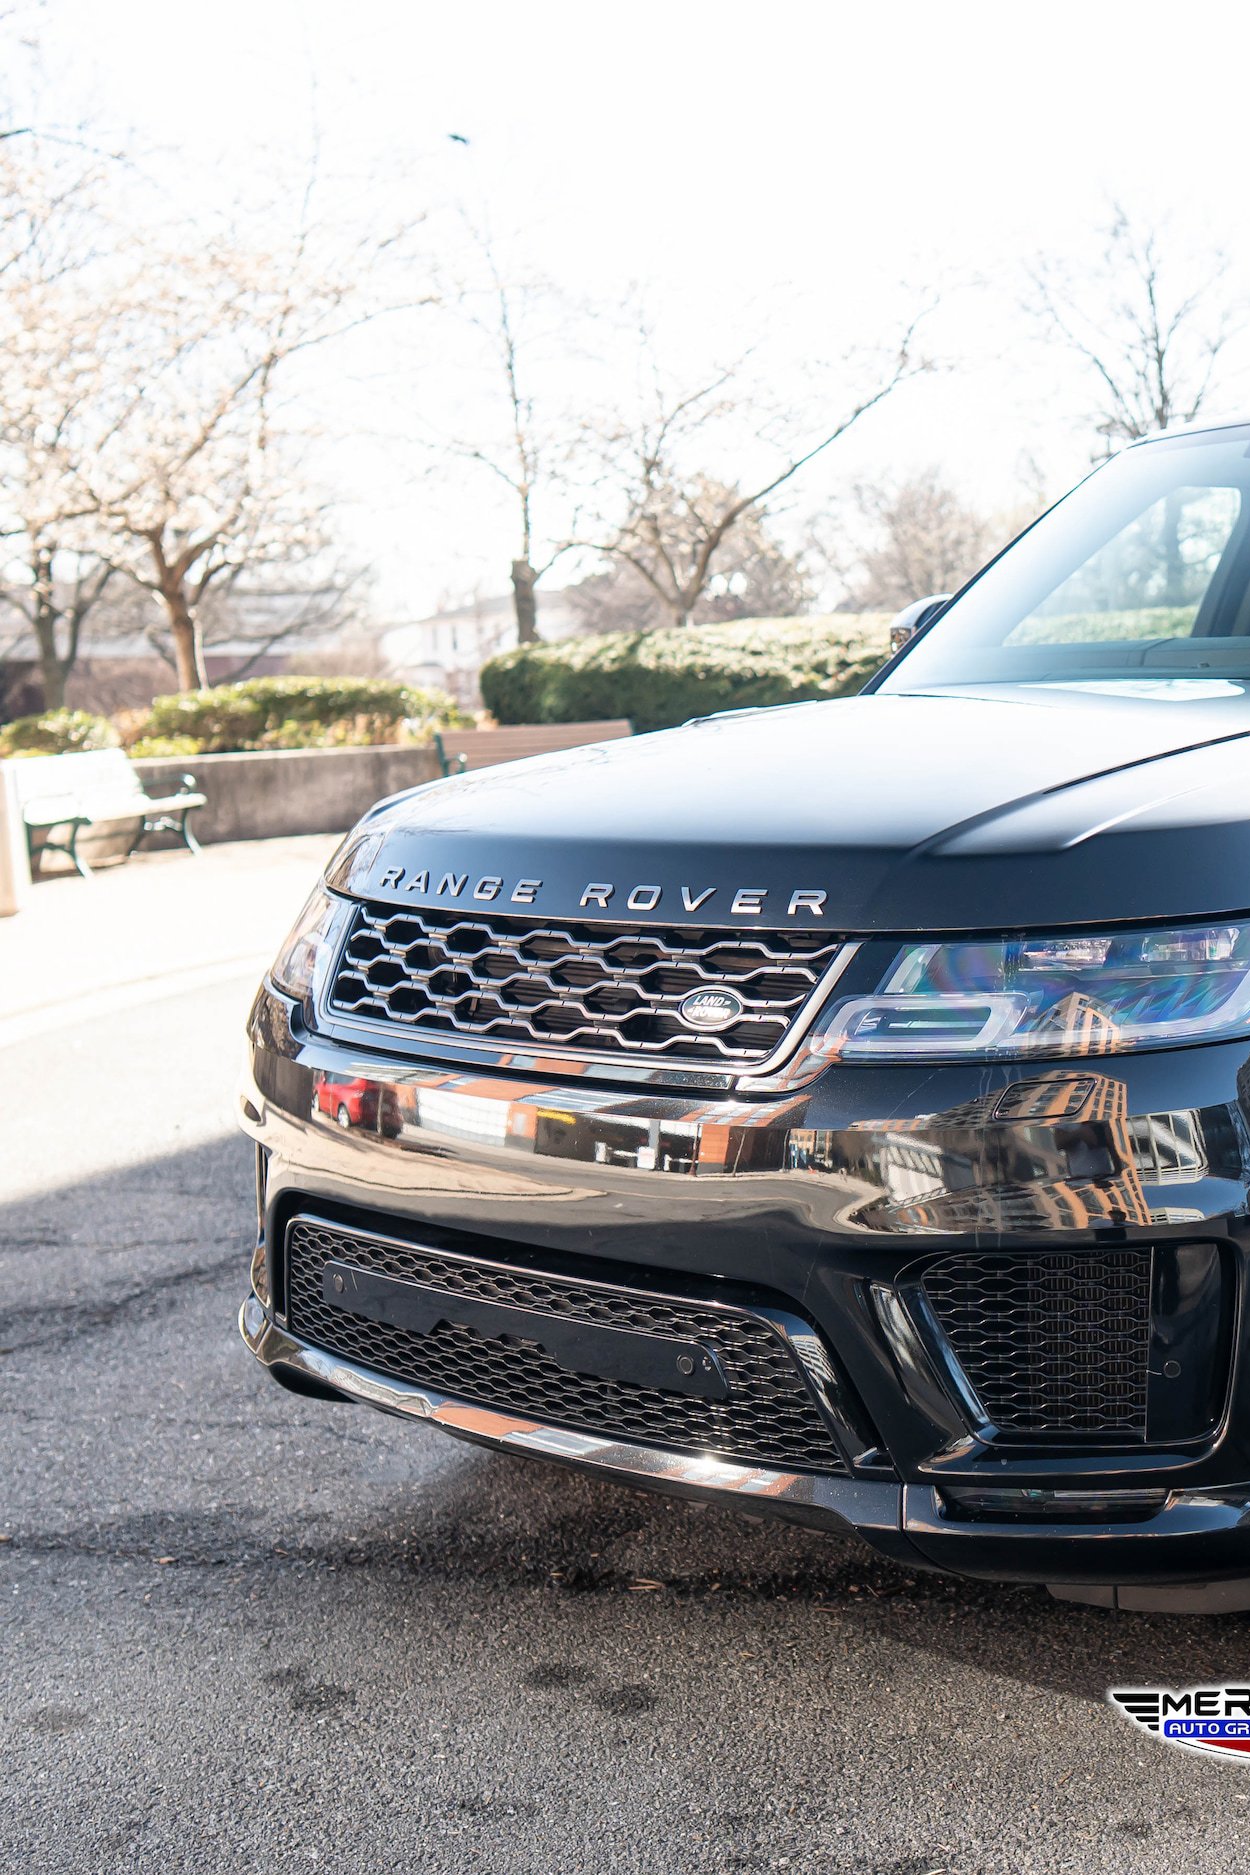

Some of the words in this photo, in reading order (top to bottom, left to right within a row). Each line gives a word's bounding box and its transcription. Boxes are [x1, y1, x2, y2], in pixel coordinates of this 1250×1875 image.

[380, 866, 543, 903] RANGE
[579, 882, 828, 915] ROVER
[692, 995, 725, 1006] LAND
[691, 1005, 731, 1019] ROVR
